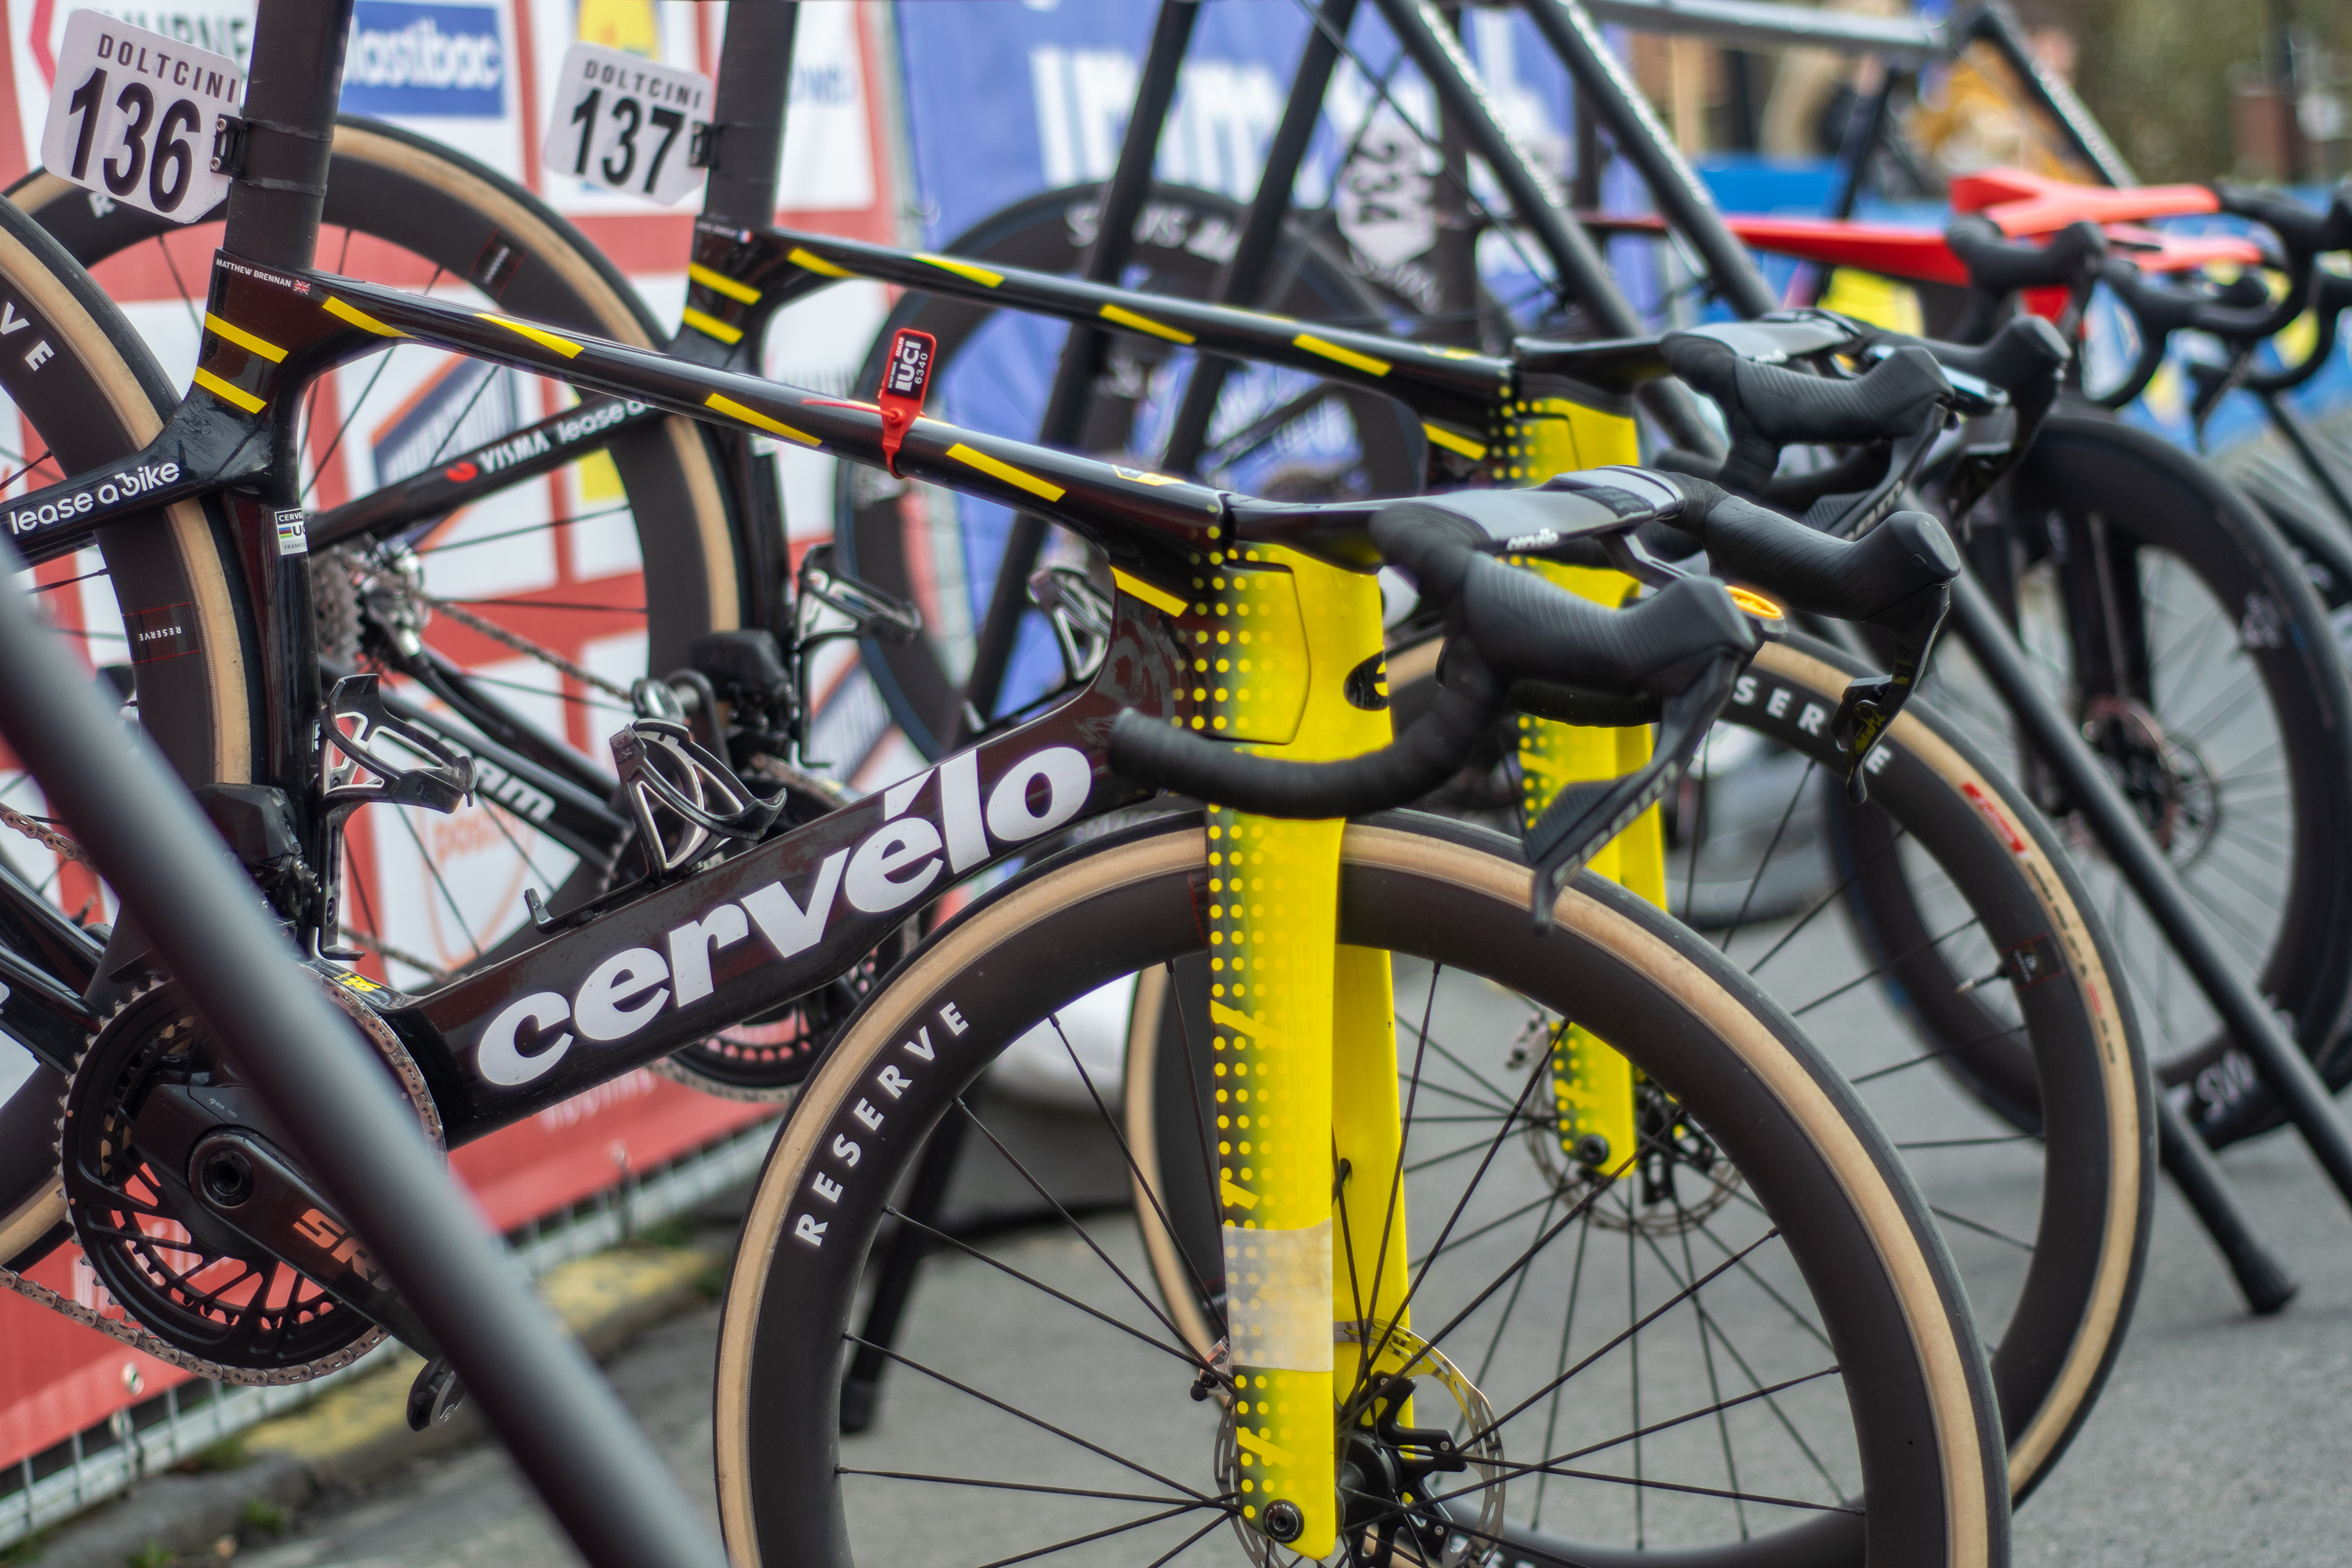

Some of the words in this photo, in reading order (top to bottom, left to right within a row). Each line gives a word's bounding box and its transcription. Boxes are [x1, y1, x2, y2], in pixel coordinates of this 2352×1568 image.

[97, 33, 237, 103] DOLTCINI
[583, 59, 702, 110] DOLTCINI
[69, 67, 201, 213] 136
[571, 87, 686, 195] 137
[216, 258, 252, 276] MATTHEW
[253, 270, 292, 288] BRENNAN
[895, 337, 904, 358] SEALED
[898, 340, 921, 382] UCI
[914, 353, 928, 384] 6340
[478, 429, 552, 474] VISMA
[557, 401, 627, 445] lease
[9, 492, 94, 535] lease
[98, 484, 120, 504] a
[115, 463, 180, 497] bike
[138, 626, 182, 641] RESERVE
[1731, 675, 1892, 775] SERE
[477, 746, 1092, 1087] cervélo
[210, 1152, 227, 1164] dub
[794, 1001, 970, 1247] RESERVE
